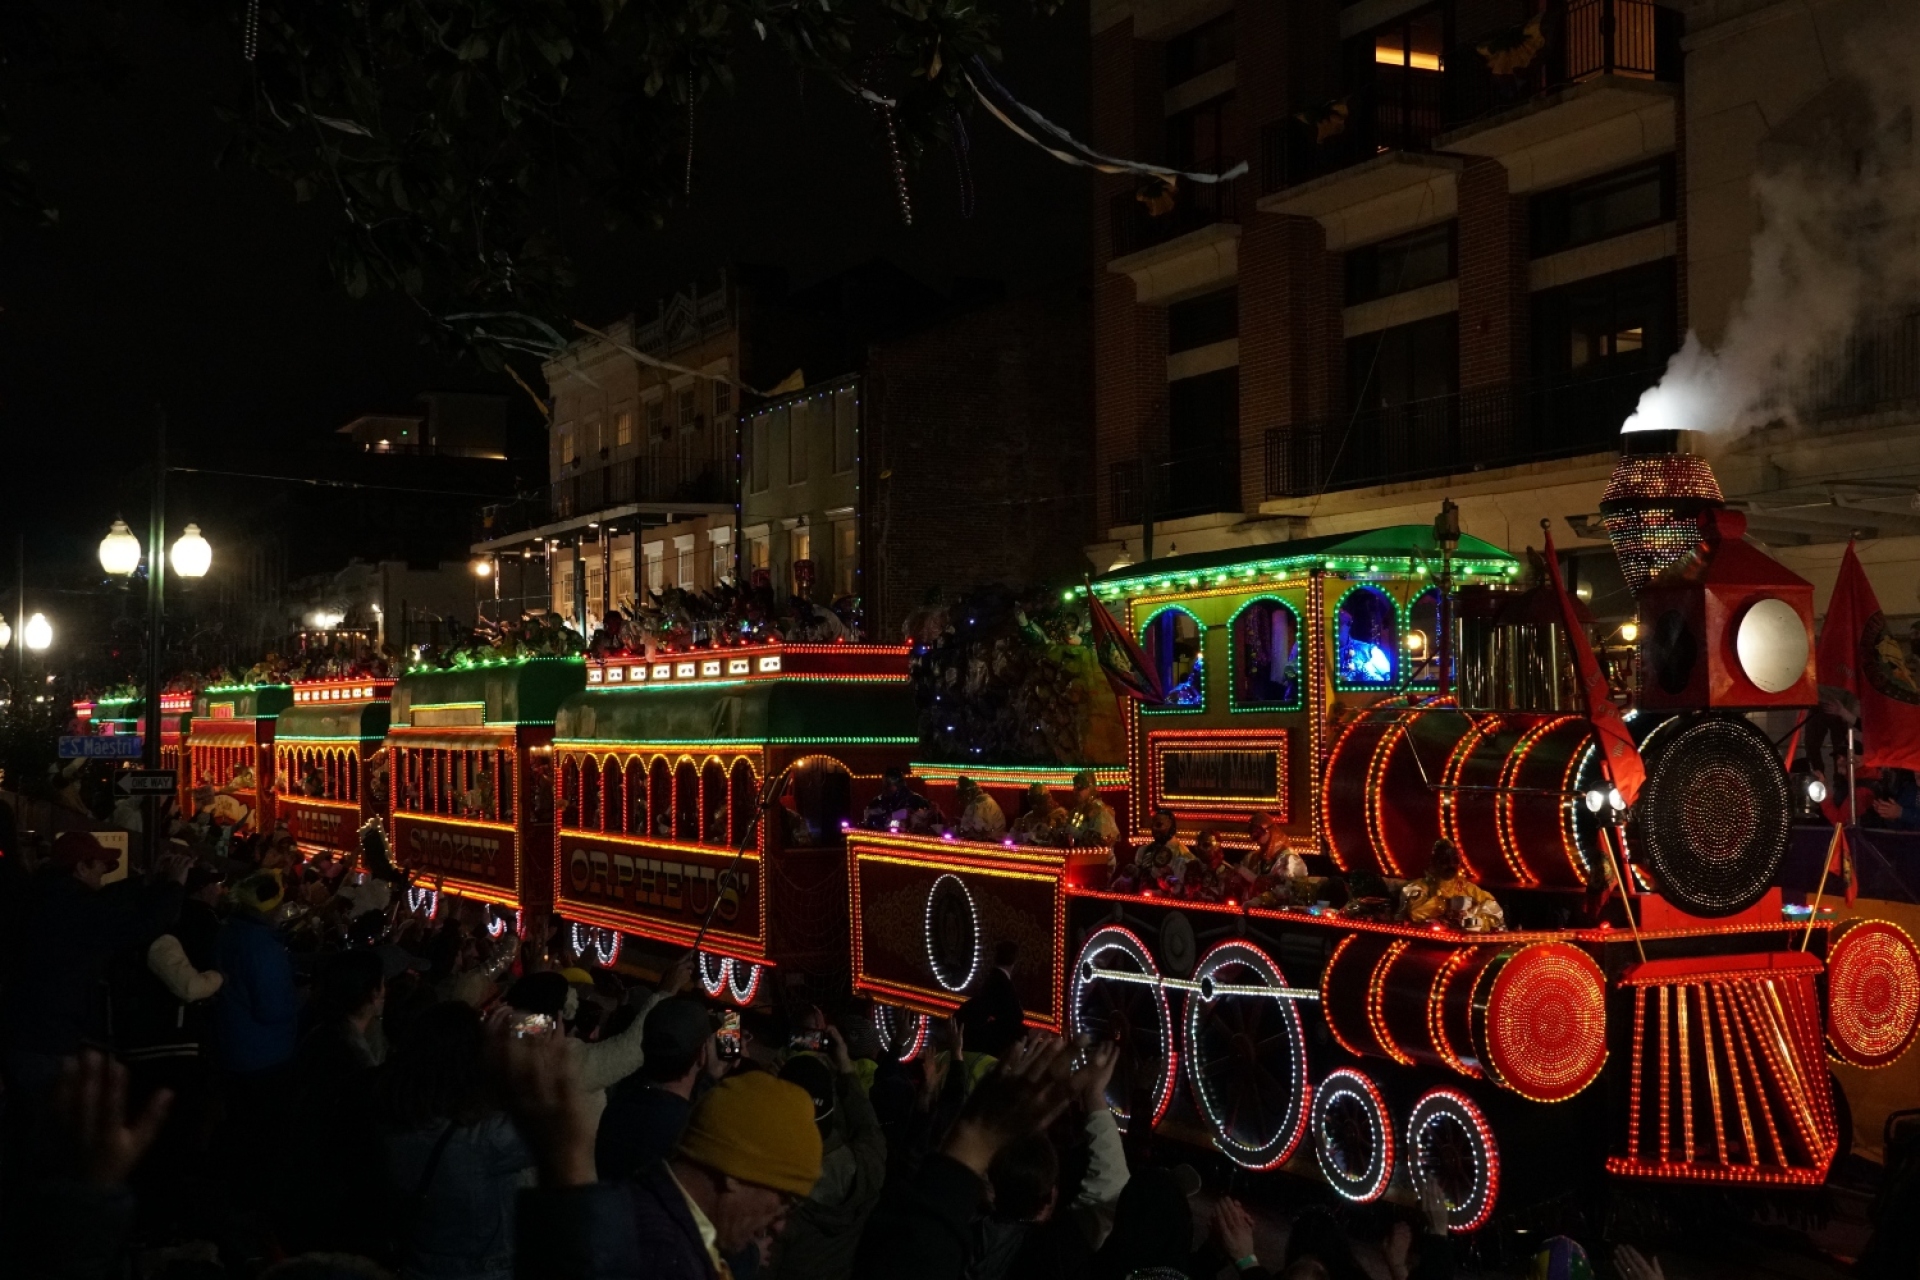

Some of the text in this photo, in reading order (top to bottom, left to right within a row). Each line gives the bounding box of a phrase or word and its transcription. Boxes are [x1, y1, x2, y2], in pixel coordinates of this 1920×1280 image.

[84, 738, 132, 755] Maestri
[131, 777, 170, 788] ONE WAY
[1178, 752, 1267, 790] SMOKEY MARY
[410, 827, 500, 877] SMOKEY
[570, 847, 750, 922] ORPHEUS'
